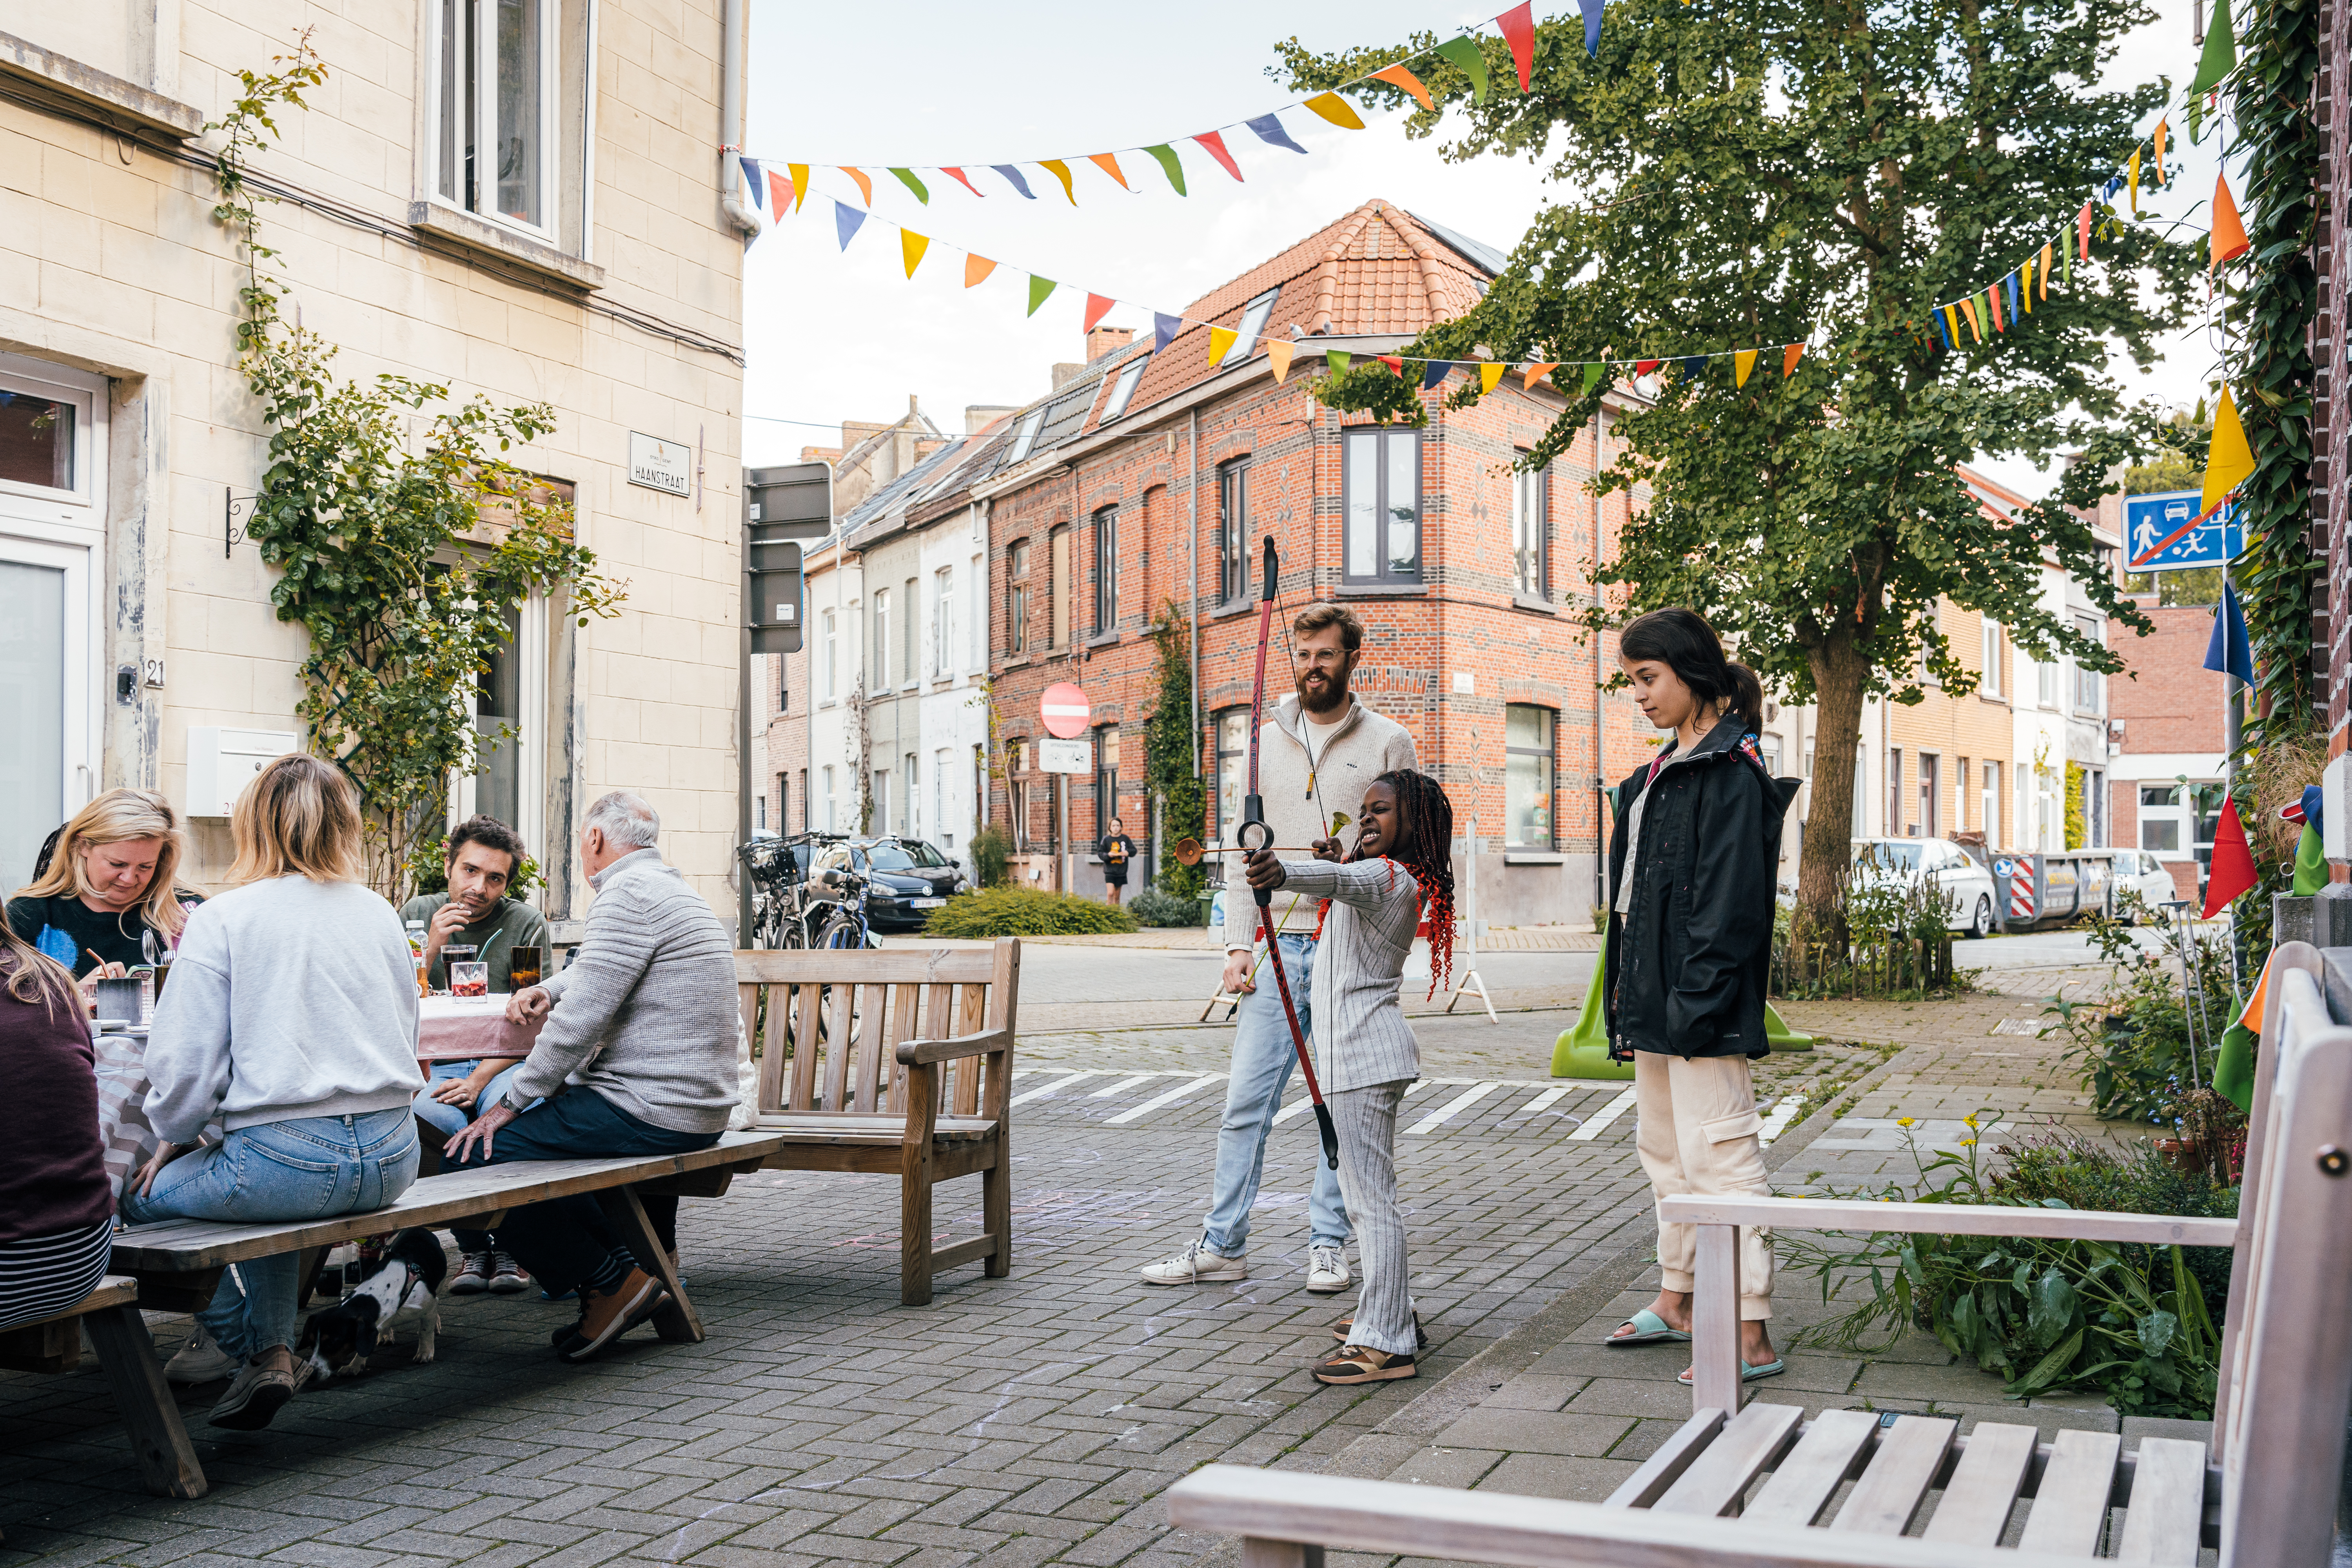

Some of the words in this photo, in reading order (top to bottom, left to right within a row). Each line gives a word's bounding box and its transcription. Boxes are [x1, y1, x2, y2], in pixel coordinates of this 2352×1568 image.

[636, 466, 684, 490] HAANSTRAAT
[147, 660, 163, 685] 21
[223, 802, 234, 814] 21
[1262, 906, 1274, 940] GEOLOGIC
